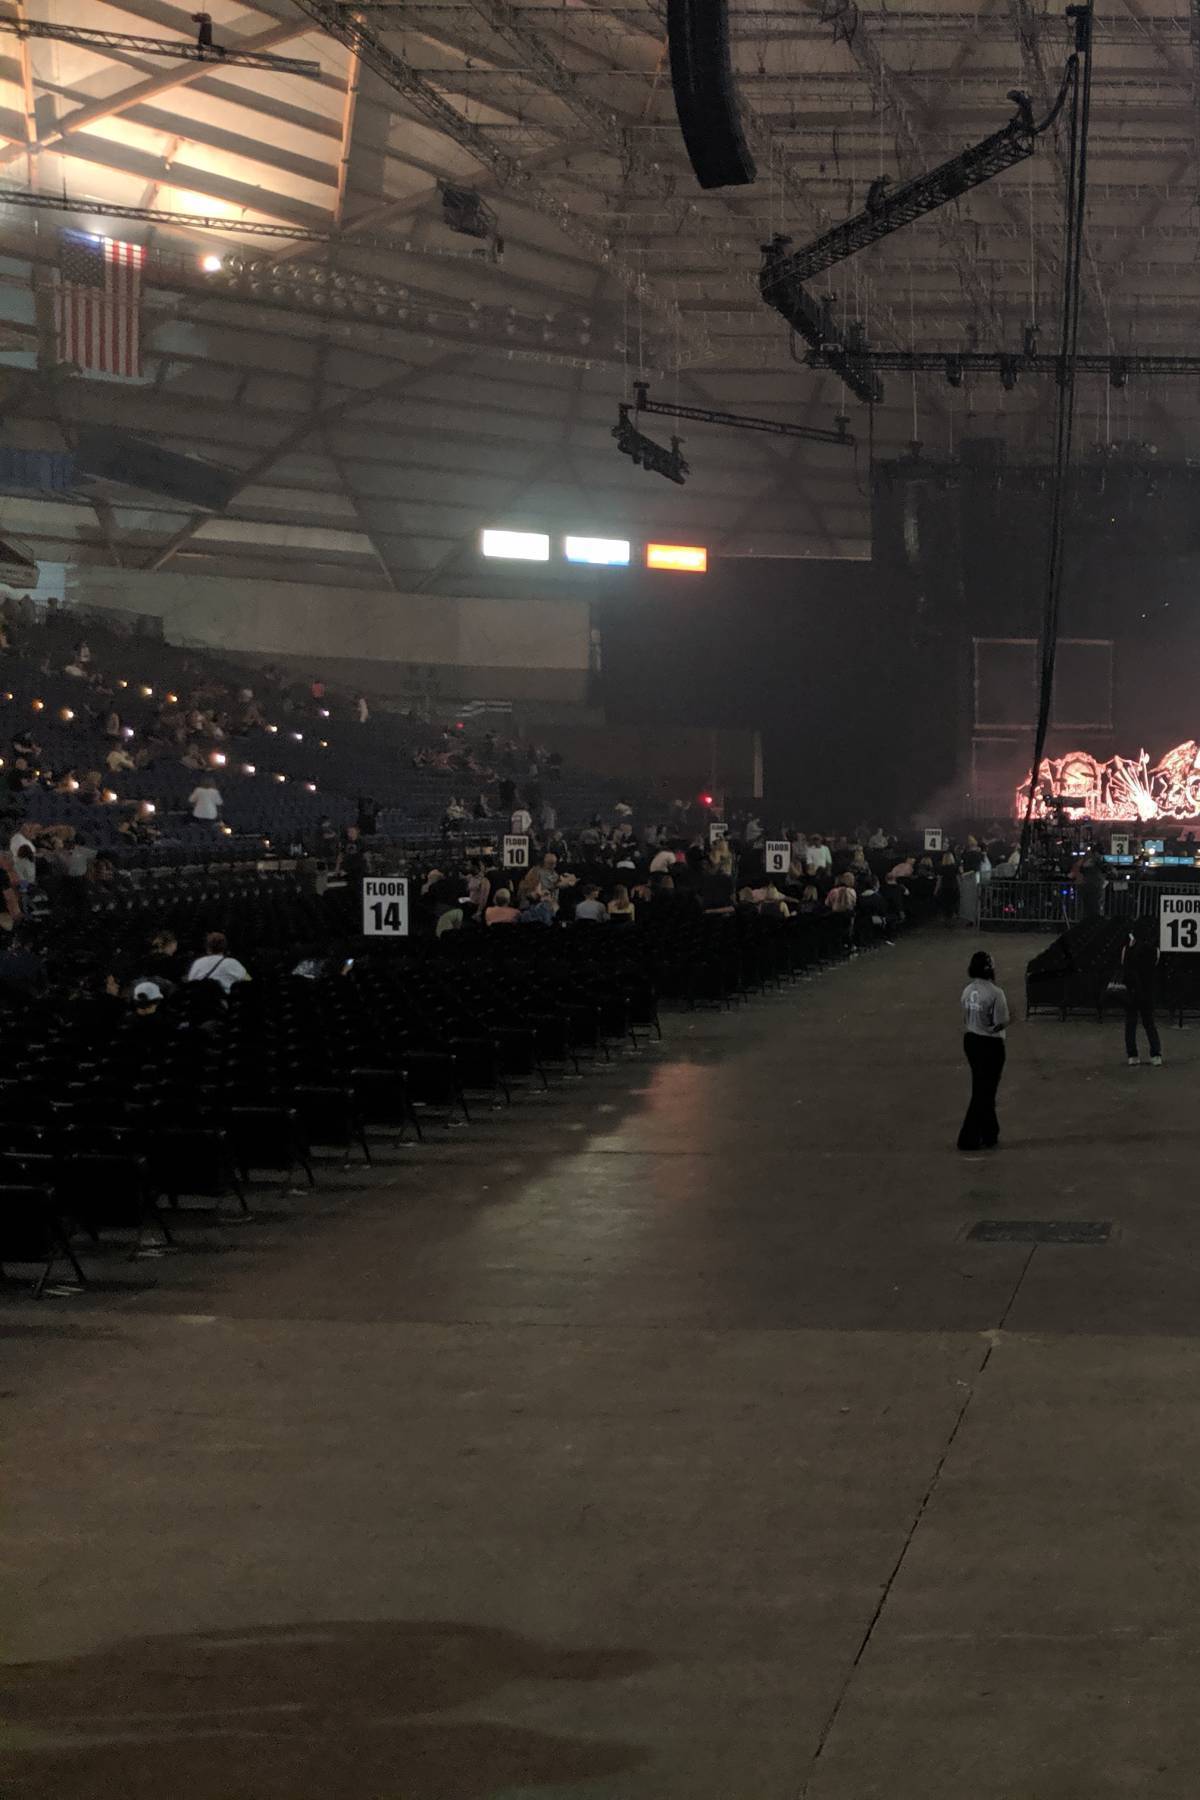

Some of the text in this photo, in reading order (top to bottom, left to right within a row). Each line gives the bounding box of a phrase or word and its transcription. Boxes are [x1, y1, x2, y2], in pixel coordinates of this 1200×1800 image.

[506, 838, 527, 846] FLOOR
[768, 843, 789, 852] FLOOR
[928, 838, 936, 849] 4
[1116, 843, 1124, 855] 3
[508, 849, 525, 865] 10
[773, 854, 783, 870] 9
[366, 882, 405, 896] FLOOR
[370, 902, 401, 931] 14
[1166, 918, 1198, 948] 13
